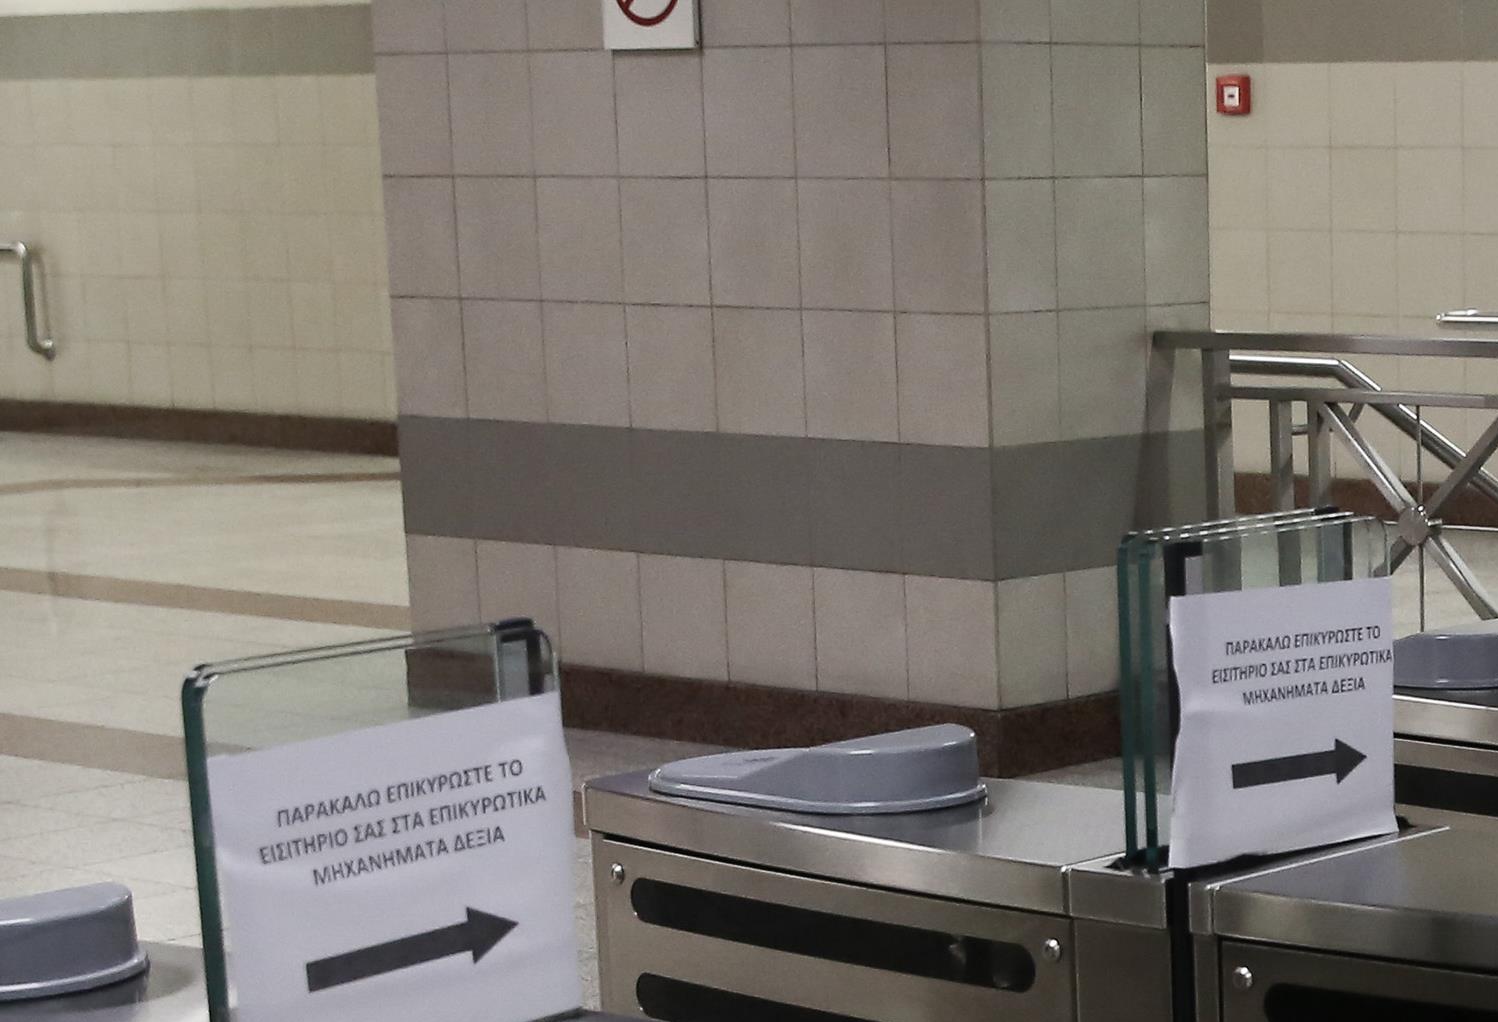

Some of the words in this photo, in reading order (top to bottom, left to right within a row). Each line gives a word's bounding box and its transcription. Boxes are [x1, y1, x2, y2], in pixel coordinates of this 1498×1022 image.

[1225, 634, 1291, 656] ΠΑΡΑΚΑΛΩ
[1294, 627, 1363, 649] ΕΠΙΚΥΡΩΣΤΕ
[1366, 625, 1381, 640] ΤΟ
[1212, 663, 1268, 684] ΕΙΣΙΤΗΡΙΟ
[1270, 659, 1292, 676] ΣΑΣ
[1294, 657, 1316, 673] ΣΤΑ
[1319, 649, 1393, 670] ΕΠΙΚΥΡΩΤΙΚΑ
[1242, 681, 1329, 706] ΜΗΧΑΝΗΜΑΤΑ
[1331, 676, 1366, 695] ΔΕΞΙΑ
[277, 788, 381, 829] ΠΑΡΑΚΑΛΩ
[386, 765, 494, 804] ΕΠΙΚΥΡΩΣΤΕ
[498, 759, 524, 779] ΤΟ
[259, 828, 349, 865] ΕΙΣΙΤΗΡΙΟ
[354, 819, 388, 844] ΣΑΣ
[391, 811, 425, 835] ΣΤΑ
[428, 785, 547, 826] ΕΠΙΚΥΡΩΤΙΚΑ
[312, 840, 450, 887] ΜΗΧΑΝΗΜΑΤΑ
[453, 825, 506, 853] ΔΕΞΙΑ
